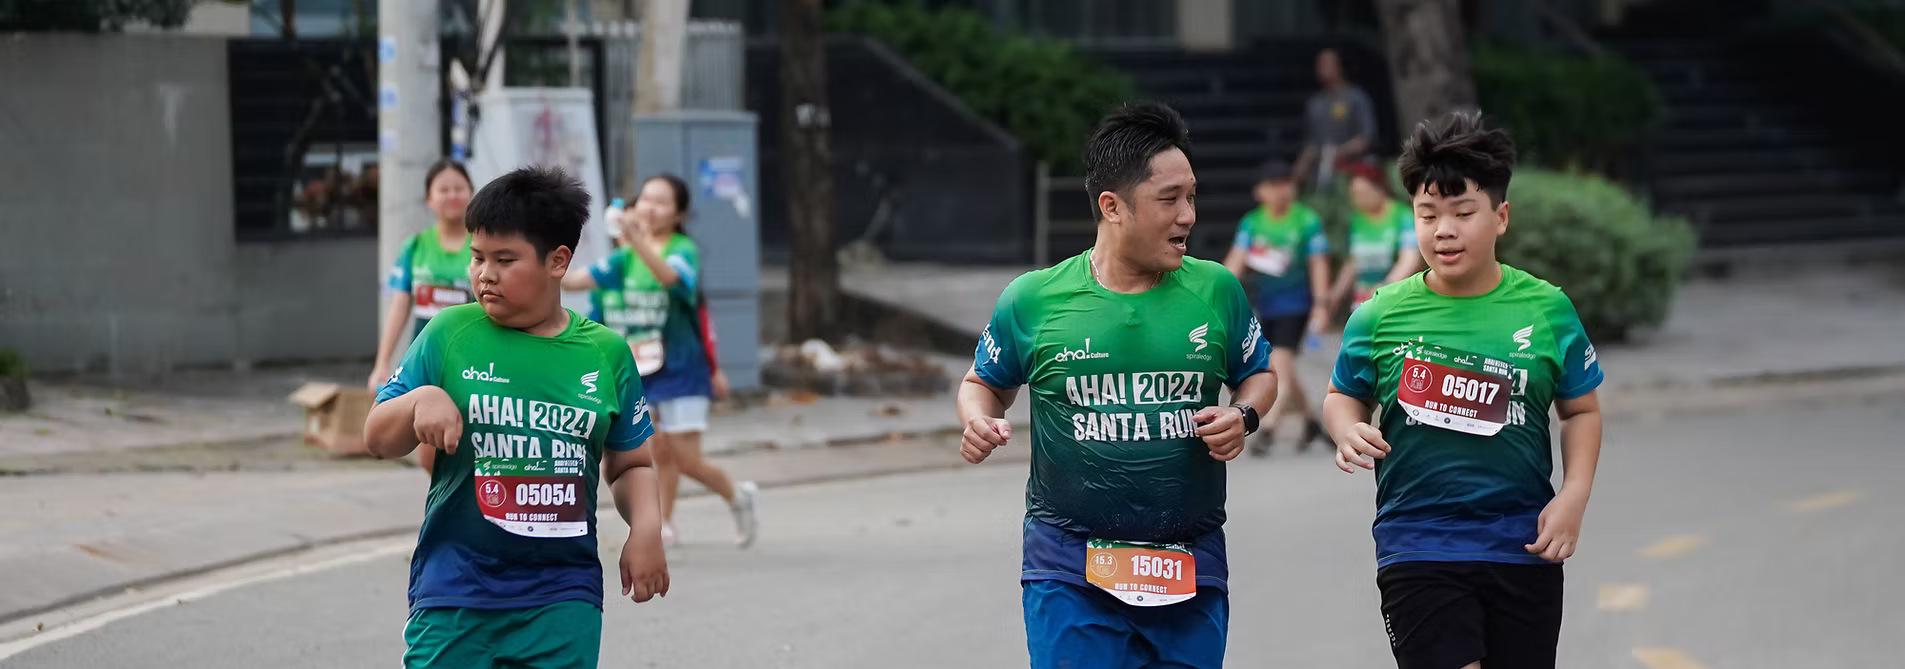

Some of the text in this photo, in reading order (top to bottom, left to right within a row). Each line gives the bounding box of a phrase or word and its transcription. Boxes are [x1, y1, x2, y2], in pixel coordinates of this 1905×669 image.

[1412, 367, 1426, 379] 5.4
[1066, 372, 1199, 406] AHA! 2024
[1442, 373, 1500, 405] 05017
[468, 394, 591, 436] AHA! 2024
[1425, 400, 1478, 418] RUN TO CONNECT
[1072, 412, 1150, 441] SANTA
[471, 432, 542, 458] SANTA
[485, 483, 499, 494] 5.4
[515, 483, 576, 506] 05054
[519, 513, 527, 521] TO
[529, 513, 558, 521] CONNECT
[1095, 555, 1113, 565] 15.3
[1131, 555, 1182, 581] 15031
[1139, 584, 1168, 594] CONNECT
